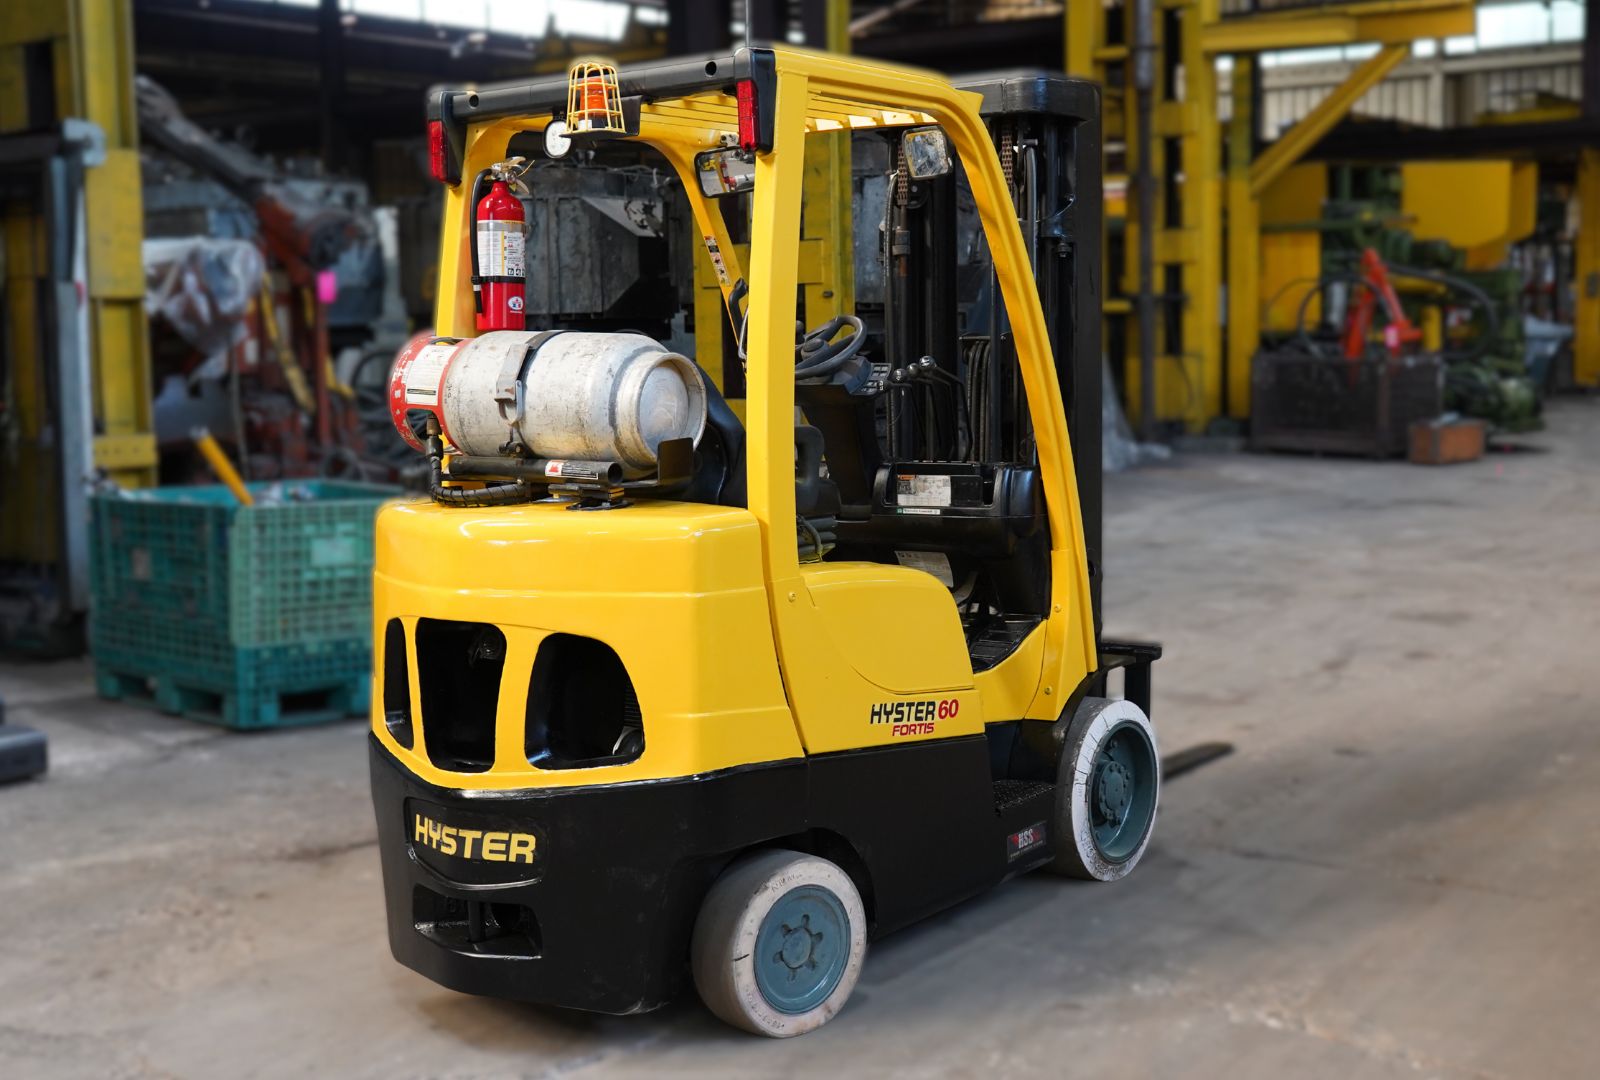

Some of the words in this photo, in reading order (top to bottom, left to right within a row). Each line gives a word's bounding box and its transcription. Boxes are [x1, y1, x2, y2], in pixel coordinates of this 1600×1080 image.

[870, 701, 935, 724] HYSTER
[938, 699, 959, 720] 60
[892, 722, 934, 737] FORTIS
[415, 813, 536, 864] HYSTER
